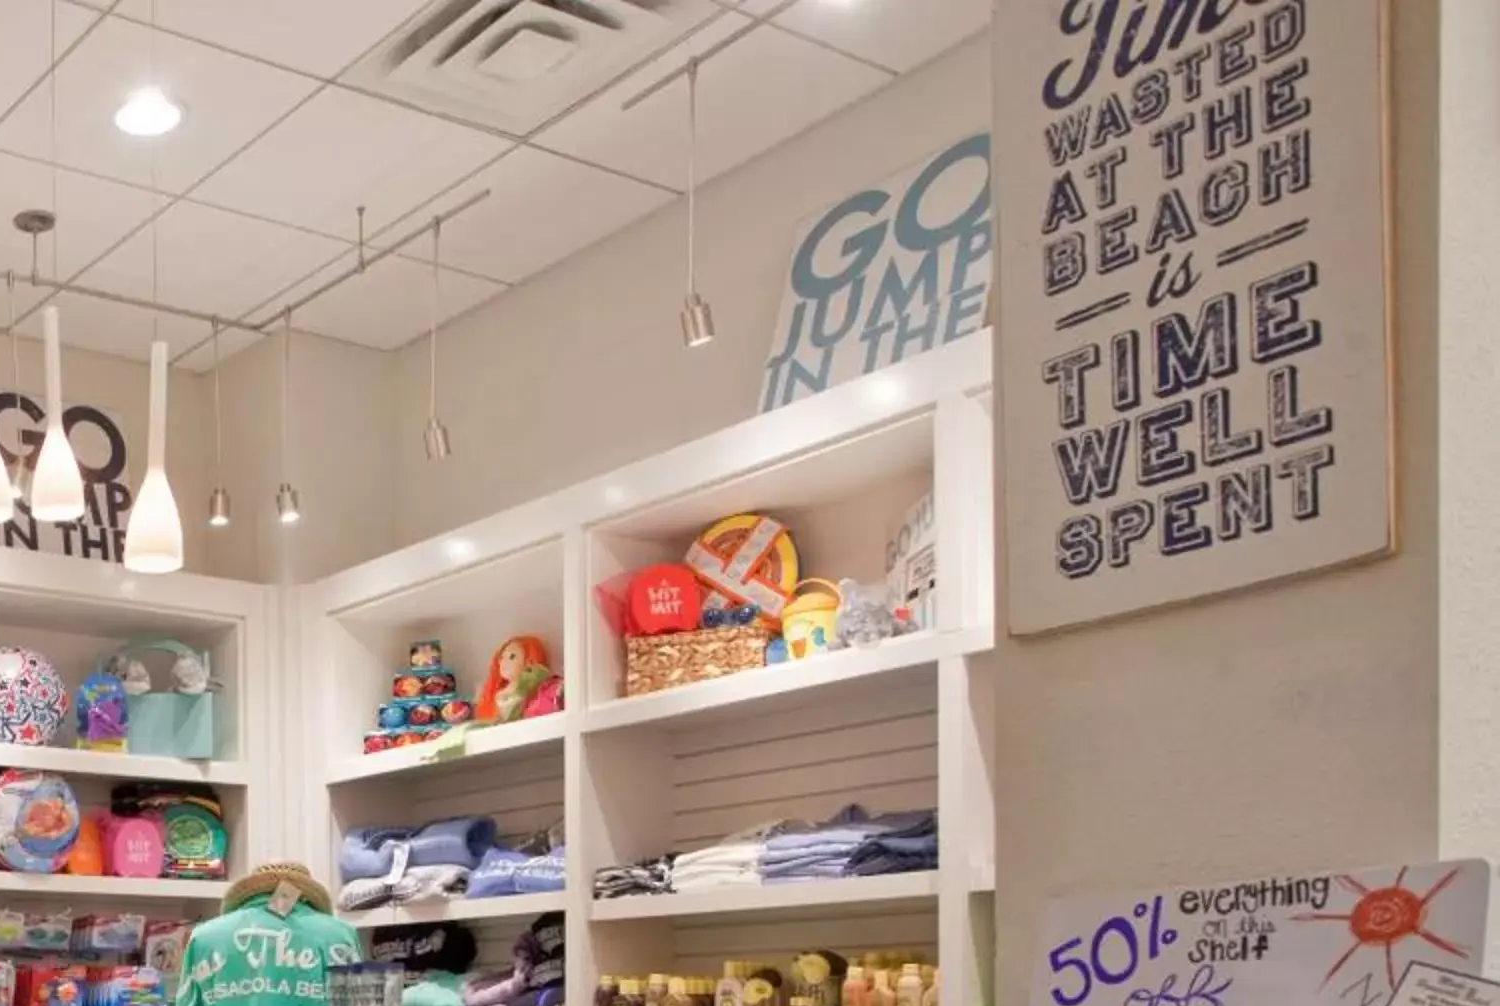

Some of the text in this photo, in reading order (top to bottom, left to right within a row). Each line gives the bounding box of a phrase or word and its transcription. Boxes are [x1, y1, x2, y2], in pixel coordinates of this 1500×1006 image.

[1042, 57, 1312, 234] AT THE
[1045, 0, 1306, 167] WASTED
[790, 133, 991, 300] GO
[1043, 128, 1311, 296] BEACH
[1148, 250, 1202, 308] is
[762, 283, 987, 413] IN THE
[766, 220, 991, 368] JUMP
[1042, 261, 1322, 429] TIME
[1052, 365, 1334, 505] WELL
[1056, 444, 1335, 580] SPENT
[233, 927, 320, 969] The
[1048, 877, 1330, 1006] 50% everything
[1187, 934, 1270, 964] shelf
[1203, 914, 1277, 938] on this
